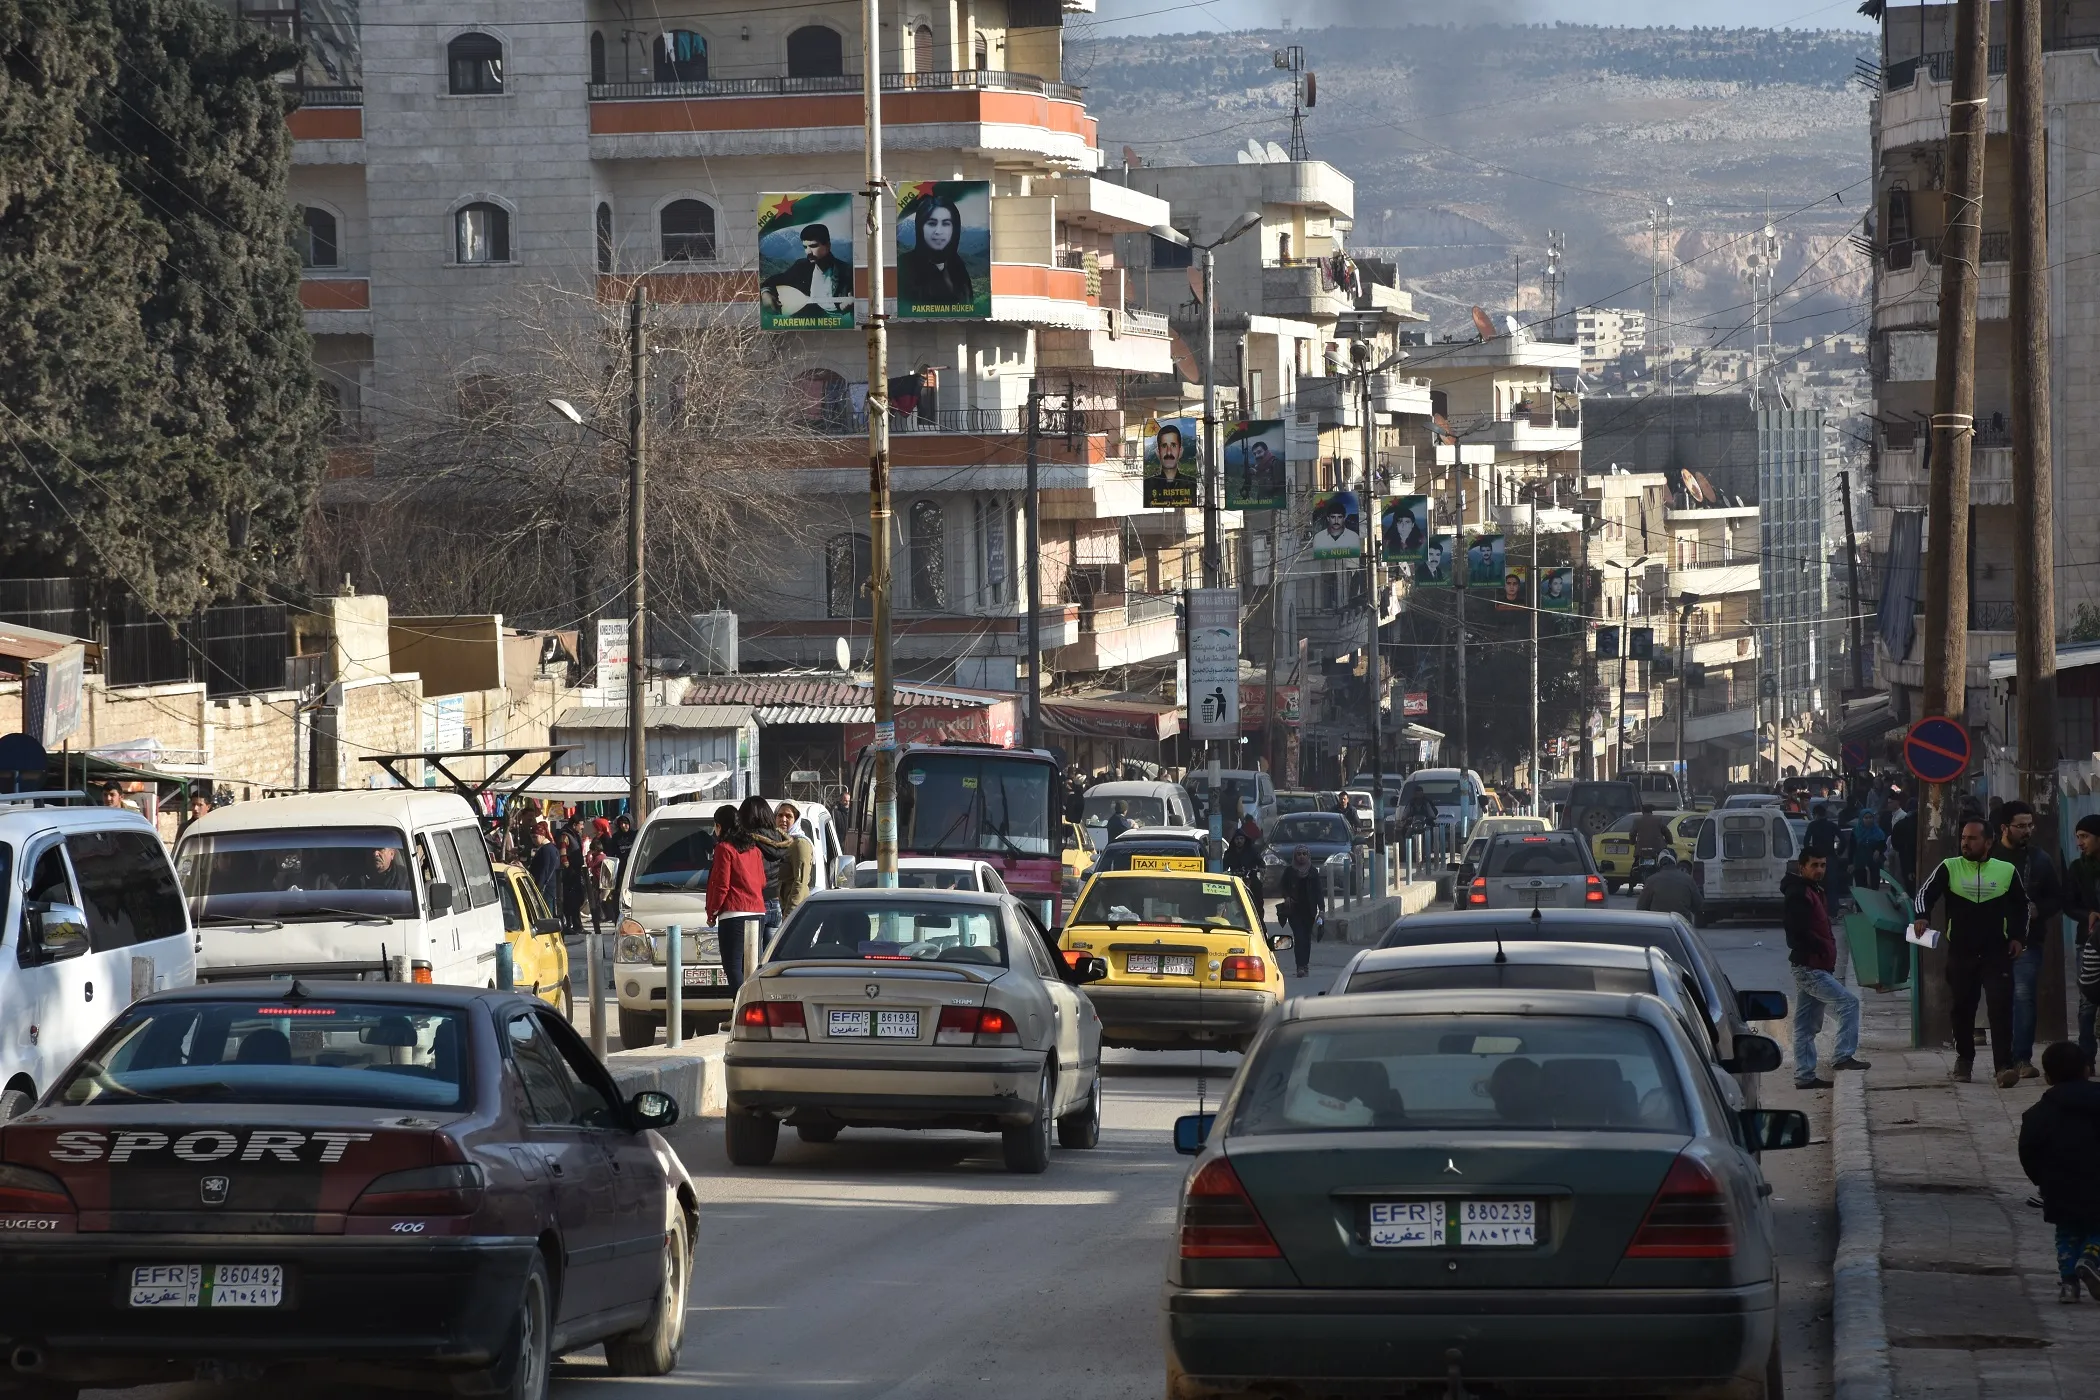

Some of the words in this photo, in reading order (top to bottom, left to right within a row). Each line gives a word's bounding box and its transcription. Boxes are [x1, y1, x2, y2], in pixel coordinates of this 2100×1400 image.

[897, 191, 917, 210] HPG
[757, 210, 775, 229] HPG
[911, 304, 950, 313] PAKREWAN
[773, 318, 815, 327] PAKREWAN
[817, 317, 842, 328] NEŞET
[1163, 488, 1191, 496] RISTEM
[899, 718, 917, 729] So
[1137, 860, 1157, 868] TAXI
[832, 1012, 860, 1022] EFR
[881, 1013, 916, 1023] 861984
[831, 1025, 860, 1034] عفرين
[880, 1026, 916, 1034] ٨٦١٩٨٤
[50, 1130, 373, 1163] SPORT
[1372, 1204, 1426, 1223] EFR
[1468, 1203, 1533, 1221] 880239
[390, 1221, 426, 1233] 406
[1434, 1204, 1443, 1241] SYR
[1373, 1227, 1426, 1244] عفرين
[134, 1267, 184, 1284] EFR
[220, 1267, 281, 1284] 860492
[189, 1268, 198, 1302] SYR
[133, 1289, 181, 1304] عفرين
